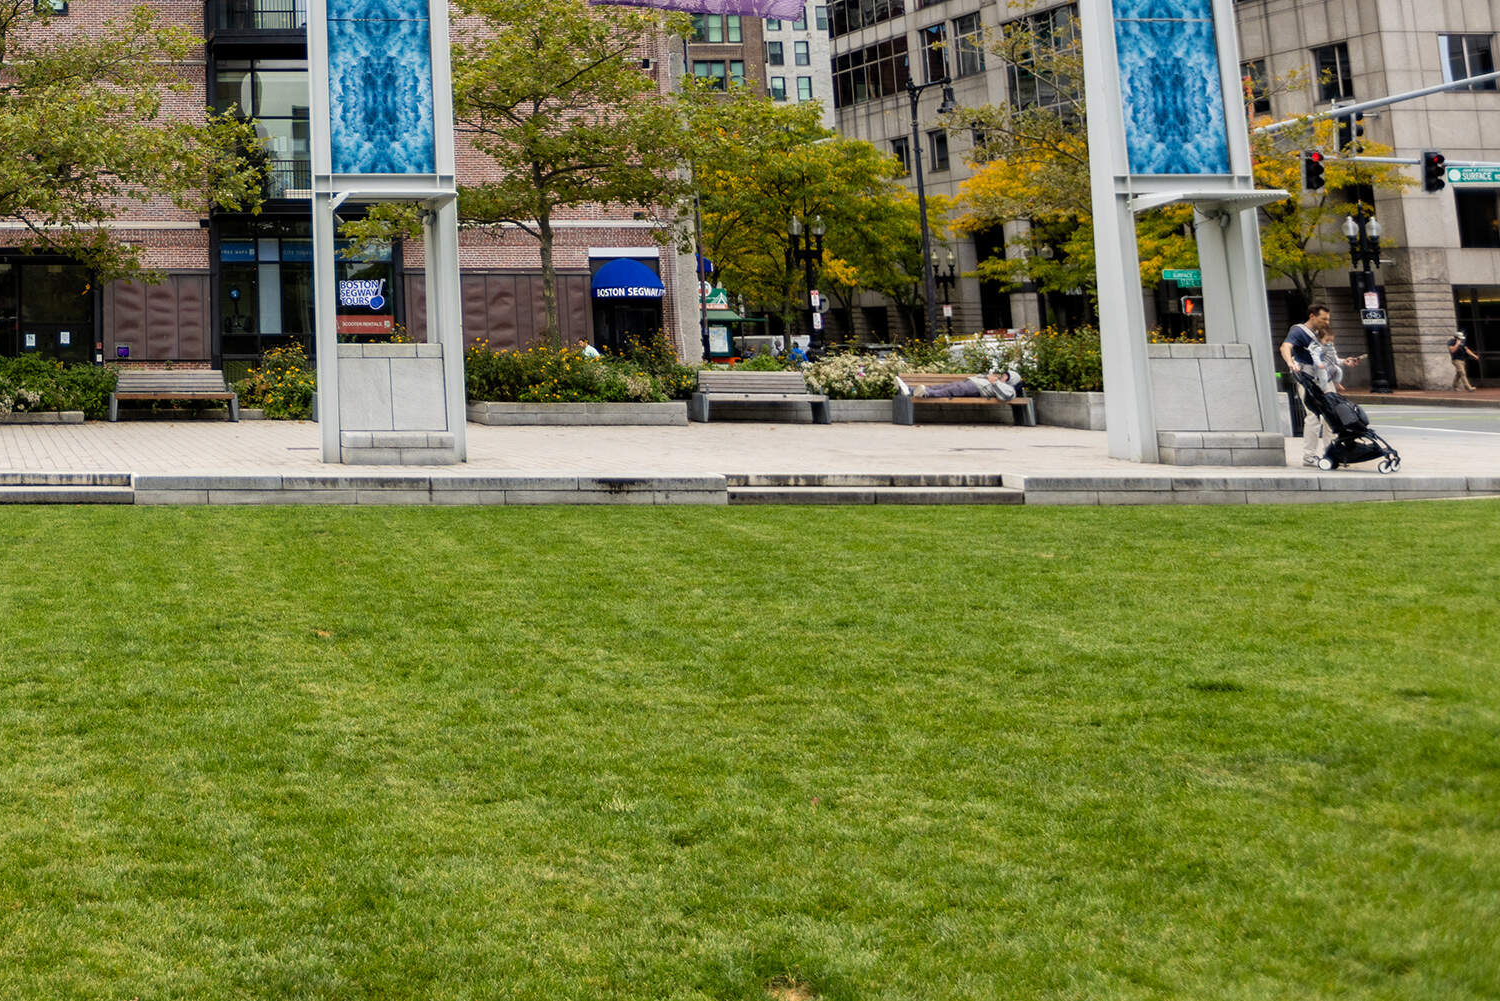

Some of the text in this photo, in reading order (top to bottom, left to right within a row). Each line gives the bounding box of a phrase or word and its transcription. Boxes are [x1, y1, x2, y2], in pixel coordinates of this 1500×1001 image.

[1462, 172, 1492, 180] SURFACE
[340, 280, 379, 289] BOSTON
[340, 289, 376, 297] SEGWAY
[597, 288, 625, 297] BOSTON
[628, 287, 659, 297] SEGWAY
[341, 297, 370, 305] TOURS
